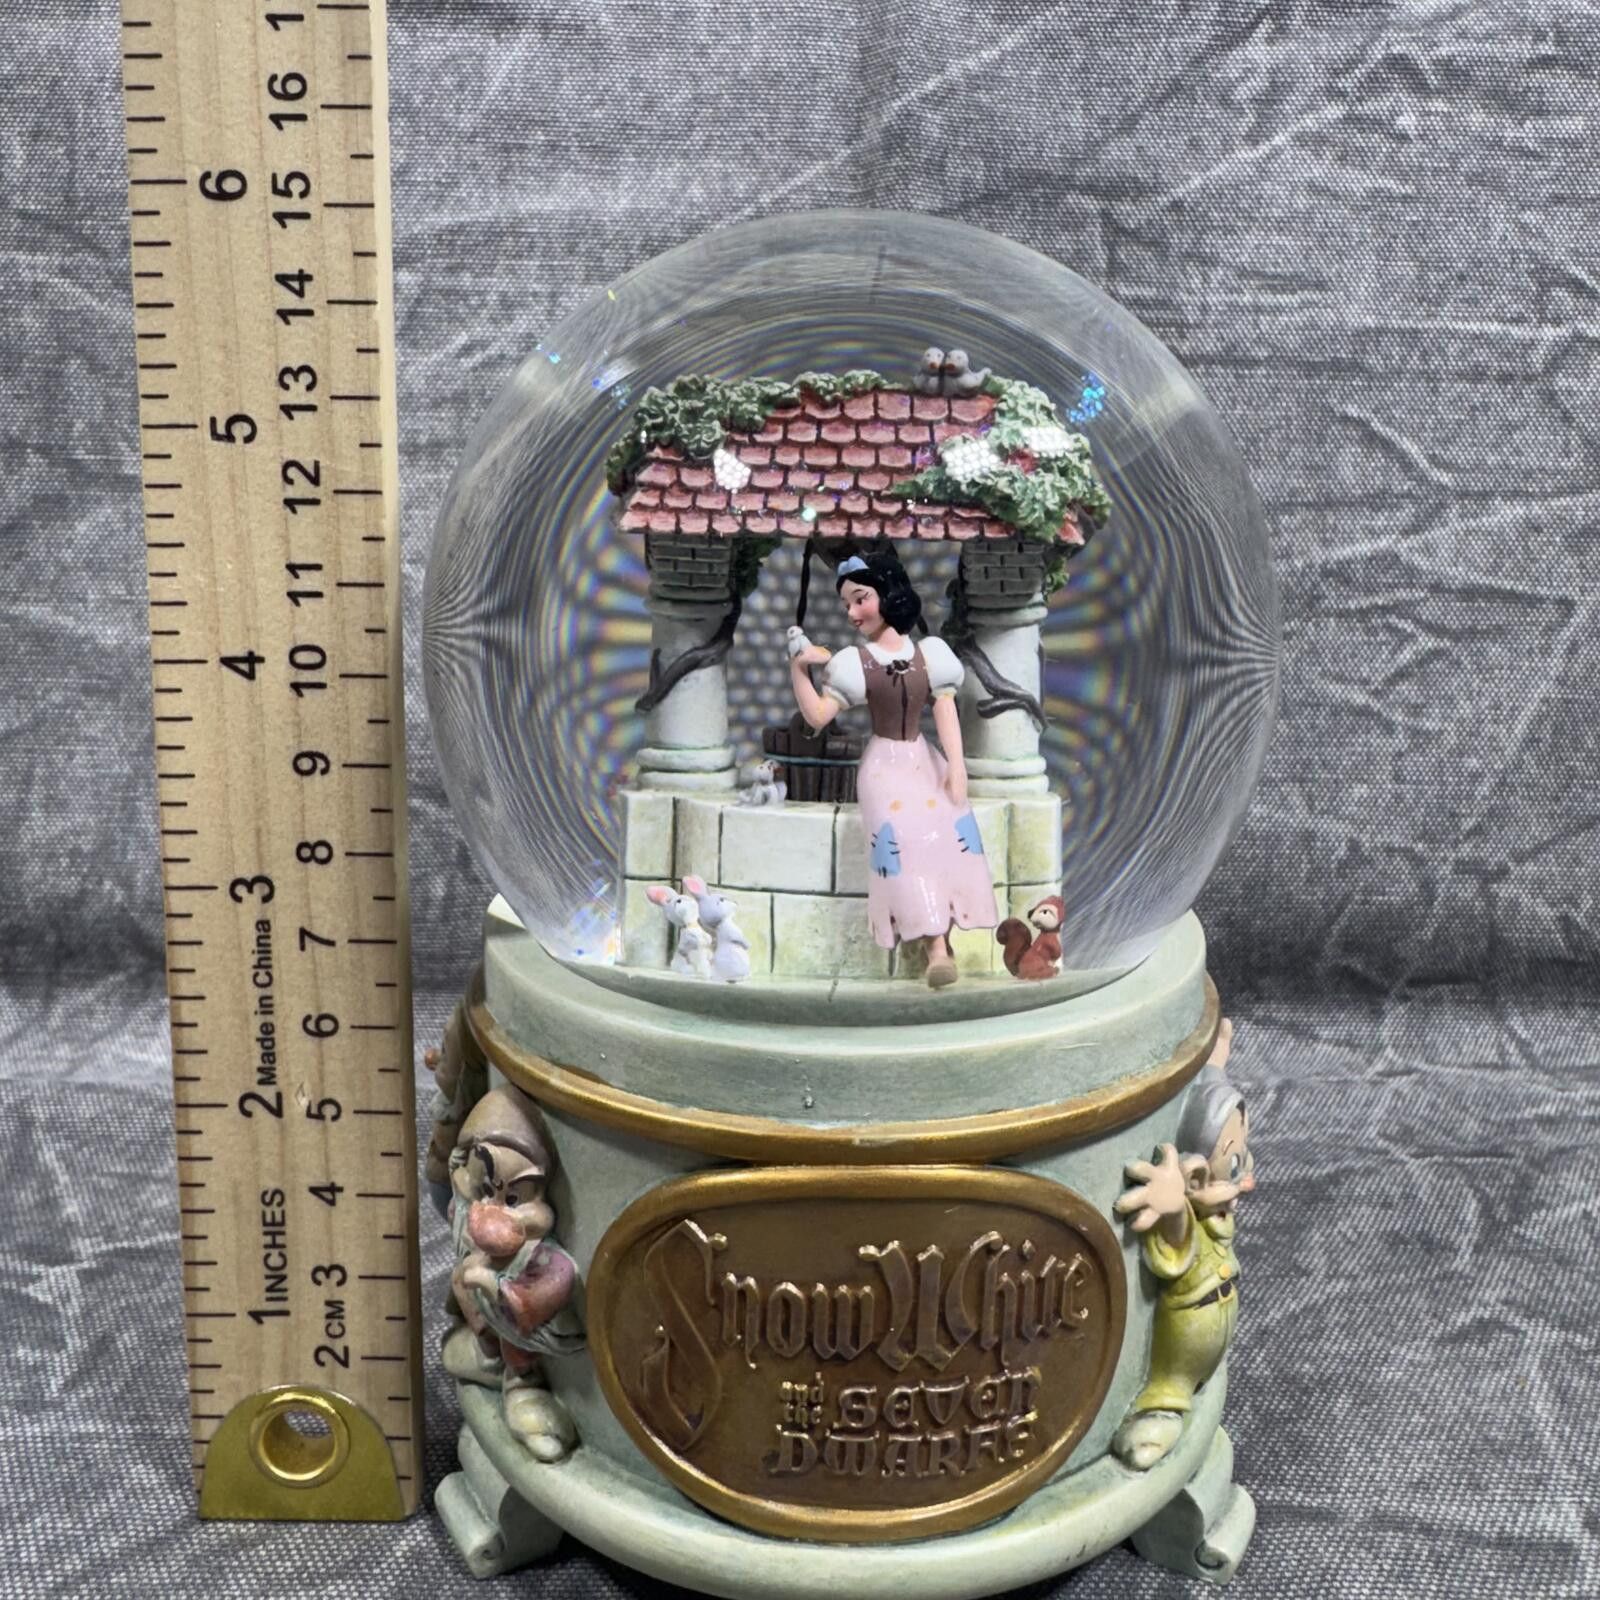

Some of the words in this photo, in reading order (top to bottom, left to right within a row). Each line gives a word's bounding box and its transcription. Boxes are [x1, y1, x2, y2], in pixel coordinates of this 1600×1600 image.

[265, 0, 304, 31] 1
[267, 72, 308, 131] 16
[199, 169, 247, 201] 6
[271, 171, 311, 229] 15
[274, 269, 314, 326] 14
[278, 365, 318, 421] 13
[209, 414, 257, 444] 5
[281, 460, 321, 515] 12
[285, 563, 324, 607] 11
[219, 650, 265, 681] 4
[288, 644, 327, 698] 10
[292, 751, 330, 777] 9
[295, 839, 334, 865] 8
[229, 875, 275, 904] 3
[252, 919, 273, 989] China
[299, 927, 336, 951] 7
[254, 995, 274, 1015] in
[302, 1013, 339, 1038] 6
[256, 1022, 277, 1086] Made
[238, 1091, 283, 1119] 2
[306, 1098, 342, 1122] 5
[308, 1181, 344, 1206] 4
[260, 1188, 289, 1302] INCHES
[311, 1264, 347, 1287] 3
[247, 1310, 291, 1325] 1
[324, 1299, 346, 1339] CM
[641, 1219, 876, 1450] Snow
[858, 1230, 1094, 1373] White
[314, 1345, 349, 1368] 2
